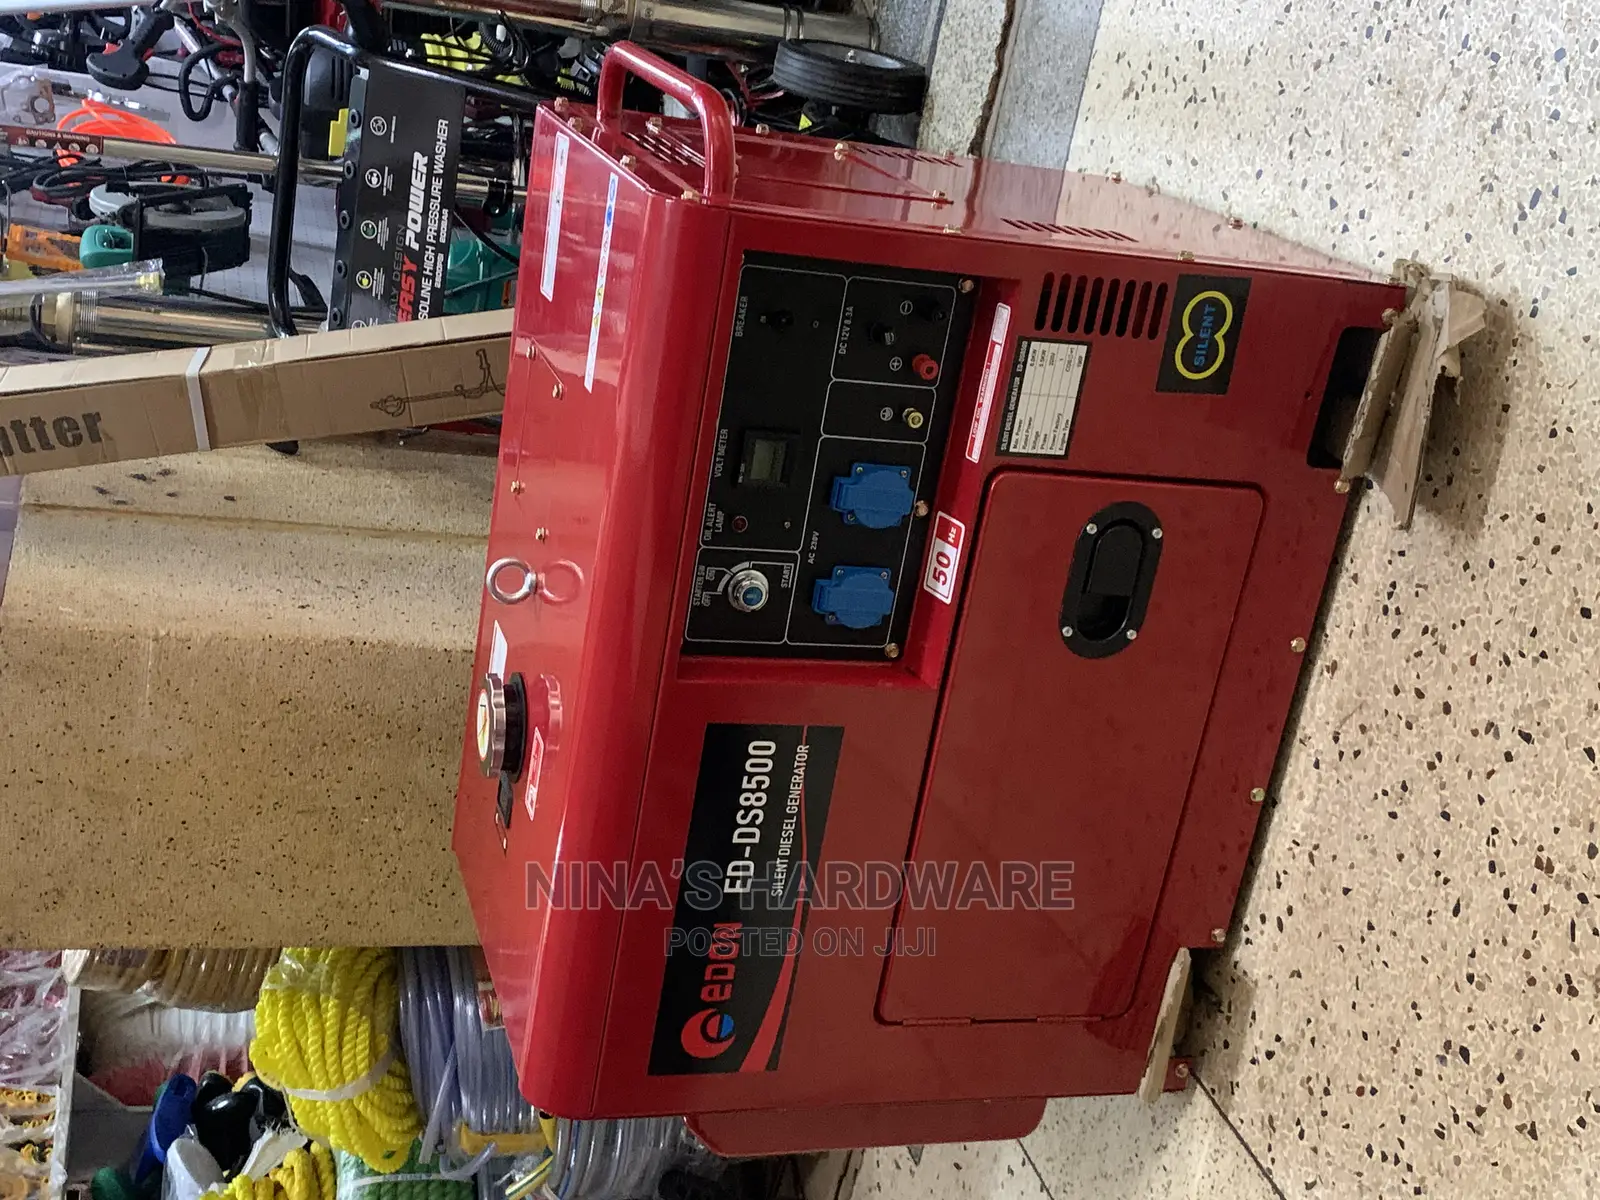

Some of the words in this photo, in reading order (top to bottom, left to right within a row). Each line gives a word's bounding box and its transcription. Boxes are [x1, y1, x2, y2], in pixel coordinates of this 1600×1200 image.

[433, 119, 449, 174] WASHER
[406, 152, 429, 250] POWER
[426, 177, 443, 243] PRESSURE
[391, 224, 406, 281] DESIGN
[424, 245, 436, 276] HIGH
[398, 255, 417, 323] EASY
[735, 296, 749, 337] BREAKER
[843, 305, 854, 325] 8.3A
[841, 326, 851, 341] 12V
[1193, 303, 1216, 368] SILENT
[838, 342, 848, 354] DC
[971, 421, 979, 438] LOW
[978, 368, 990, 404] WARNING
[1008, 376, 1020, 410] GENERATOR
[1004, 411, 1014, 430] DIESEL
[1015, 419, 1023, 436] Power
[717, 428, 729, 456] METER
[1000, 430, 1009, 451] SILENT
[1030, 431, 1040, 450] Voltage
[1040, 434, 1048, 450] Phase
[1049, 434, 1057, 450] Power
[714, 458, 725, 478] VOLT
[705, 502, 717, 526] ALERT
[715, 511, 725, 533] LAMP
[703, 529, 713, 541] OIL
[810, 530, 819, 550] 230V
[807, 553, 815, 564] AC
[932, 551, 951, 586] 50
[947, 527, 957, 543] Hz
[702, 594, 711, 606] OFF
[708, 569, 716, 581] ON
[780, 565, 791, 588] START
[693, 577, 704, 606] STARTER
[786, 744, 810, 813] GENERATOR
[722, 740, 777, 894] ED-DS8500
[778, 816, 797, 856] DIESEL
[770, 858, 790, 897] SILENT
